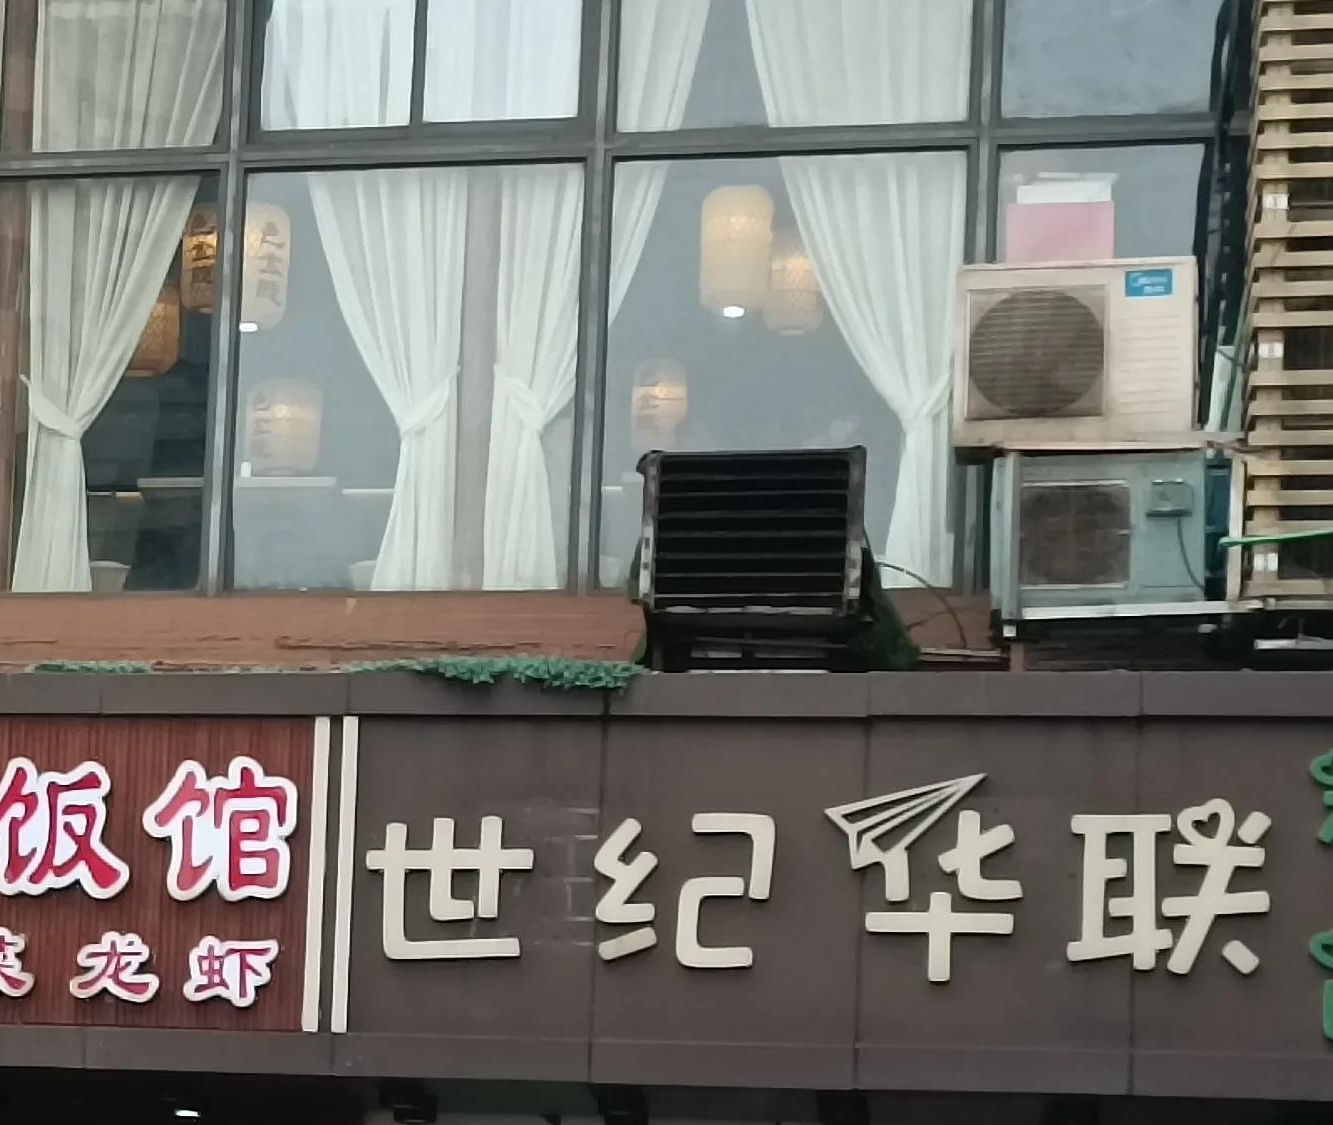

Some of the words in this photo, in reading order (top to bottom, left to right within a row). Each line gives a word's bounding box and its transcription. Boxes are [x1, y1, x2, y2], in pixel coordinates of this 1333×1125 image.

[366, 773, 1271, 982] 世纪华联
[69, 931, 281, 1009] 龙虾
